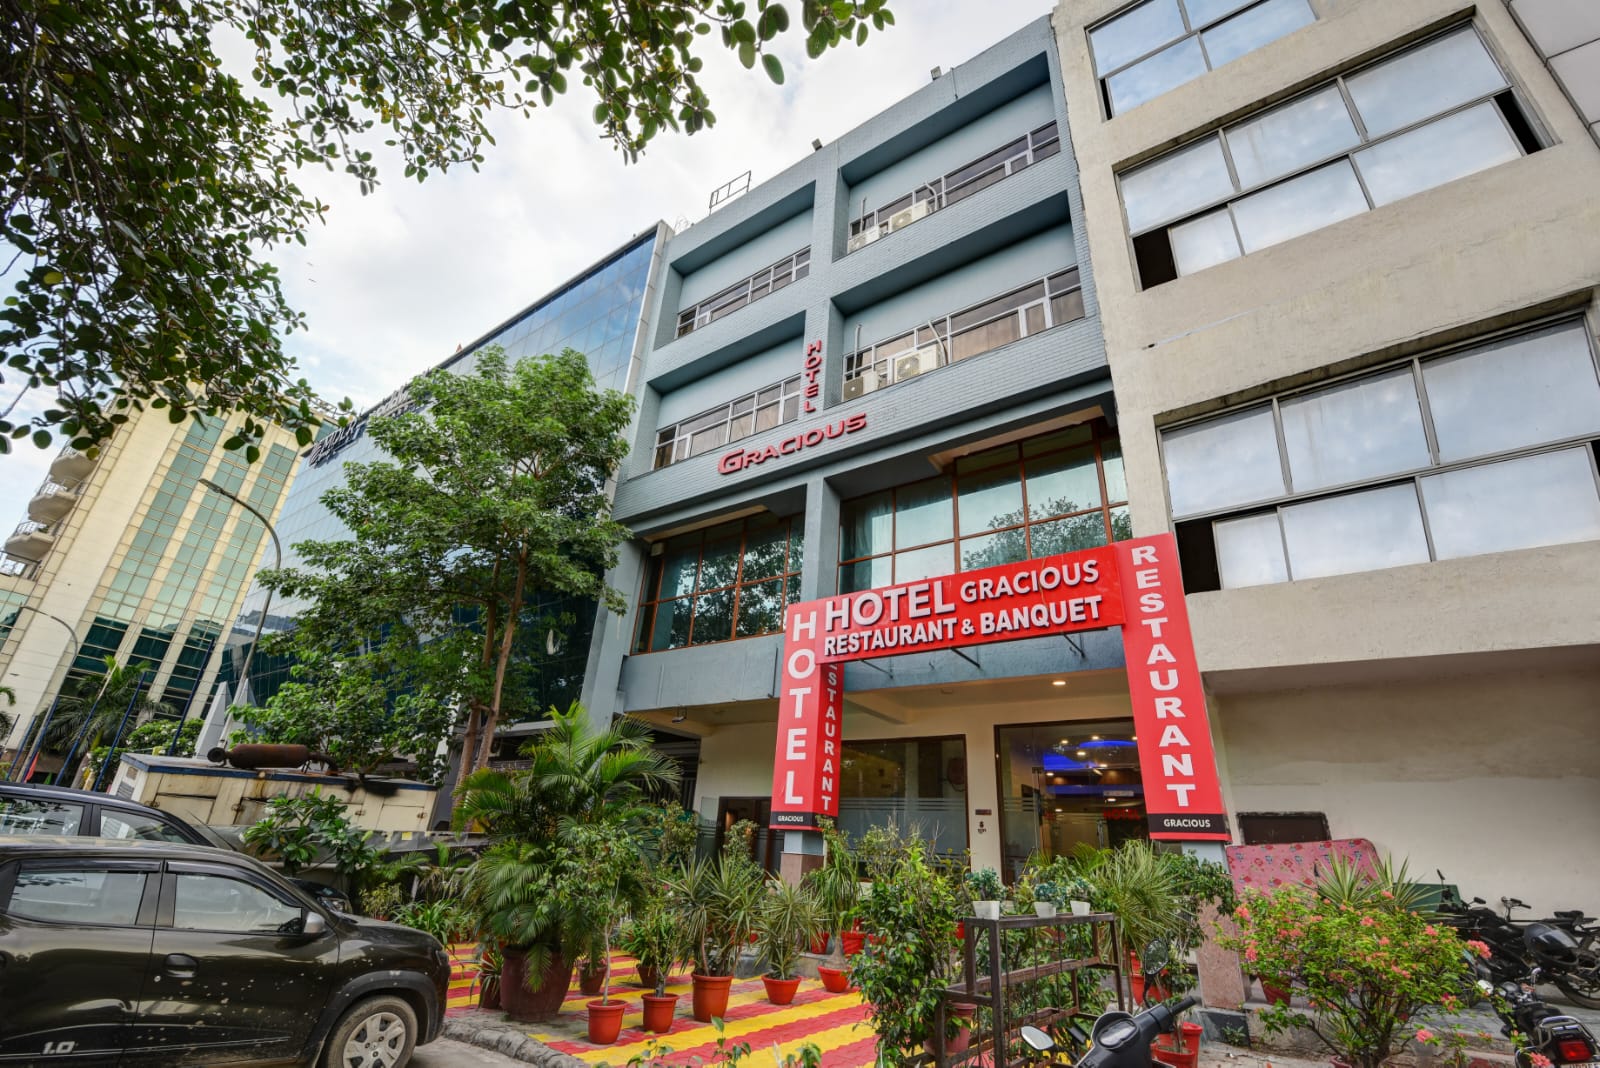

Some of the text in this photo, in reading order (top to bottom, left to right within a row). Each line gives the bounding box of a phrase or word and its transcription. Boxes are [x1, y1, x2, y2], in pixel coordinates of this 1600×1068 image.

[804, 339, 823, 413] HOTEL
[824, 559, 1099, 632] HOTEL GRACIOUS
[824, 595, 1102, 656] RESTAURANT & BANQUET
[785, 611, 817, 805] HOTEL
[1131, 545, 1196, 807] RESTAURANT
[821, 664, 838, 811] STAURANT
[777, 815, 804, 823] GRACIOUS
[1163, 817, 1212, 829] GRACIOUS
[42, 1041, 75, 1055] 1.0
